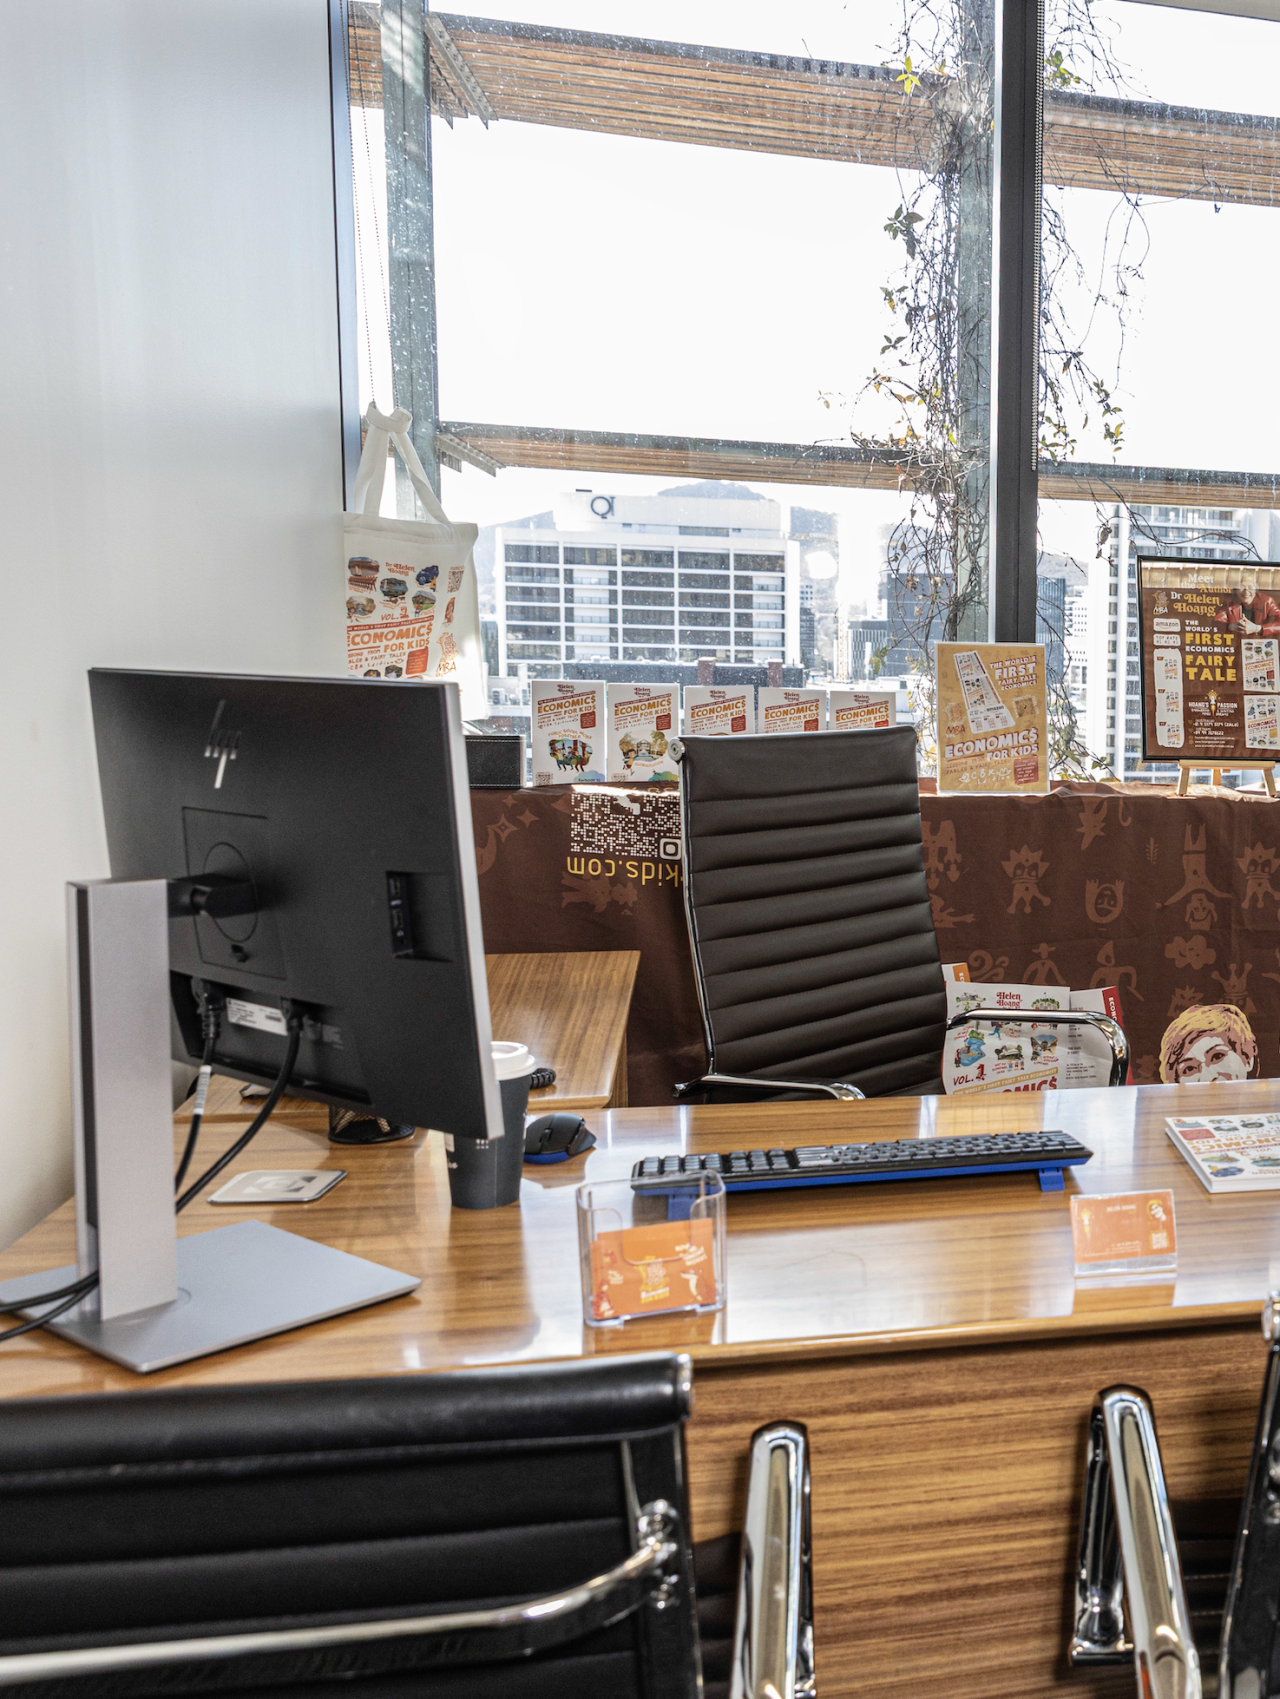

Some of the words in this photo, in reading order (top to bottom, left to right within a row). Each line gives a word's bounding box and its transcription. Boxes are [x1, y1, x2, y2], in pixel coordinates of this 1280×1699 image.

[1188, 573, 1214, 583] Meet
[1181, 580, 1196, 589] the
[1197, 583, 1233, 594] Author
[1170, 591, 1182, 599] Dr
[1183, 593, 1224, 607] Helen
[1173, 602, 1216, 617] Hoang
[384, 642, 404, 653] FOR
[407, 637, 430, 650] KIDS
[1185, 632, 1234, 645] FIRST
[990, 661, 1003, 669] THE
[1005, 655, 1036, 666] WORLD'S
[1185, 654, 1235, 667] FAIRY
[995, 662, 1037, 679] FIRST
[1185, 667, 1237, 681] TALE
[998, 677, 1018, 685] FAIRY
[1020, 673, 1037, 681] TALE
[1001, 680, 1037, 690] ECONOMICS
[579, 705, 596, 713] KIDS
[655, 707, 672, 715] KIDS
[987, 749, 1009, 762] FOR
[1011, 743, 1039, 757] KIDS
[567, 856, 683, 887] kids.com
[996, 991, 1023, 1002] Helen
[996, 1000, 1021, 1008] Hoang
[953, 1075, 974, 1086] VOL.
